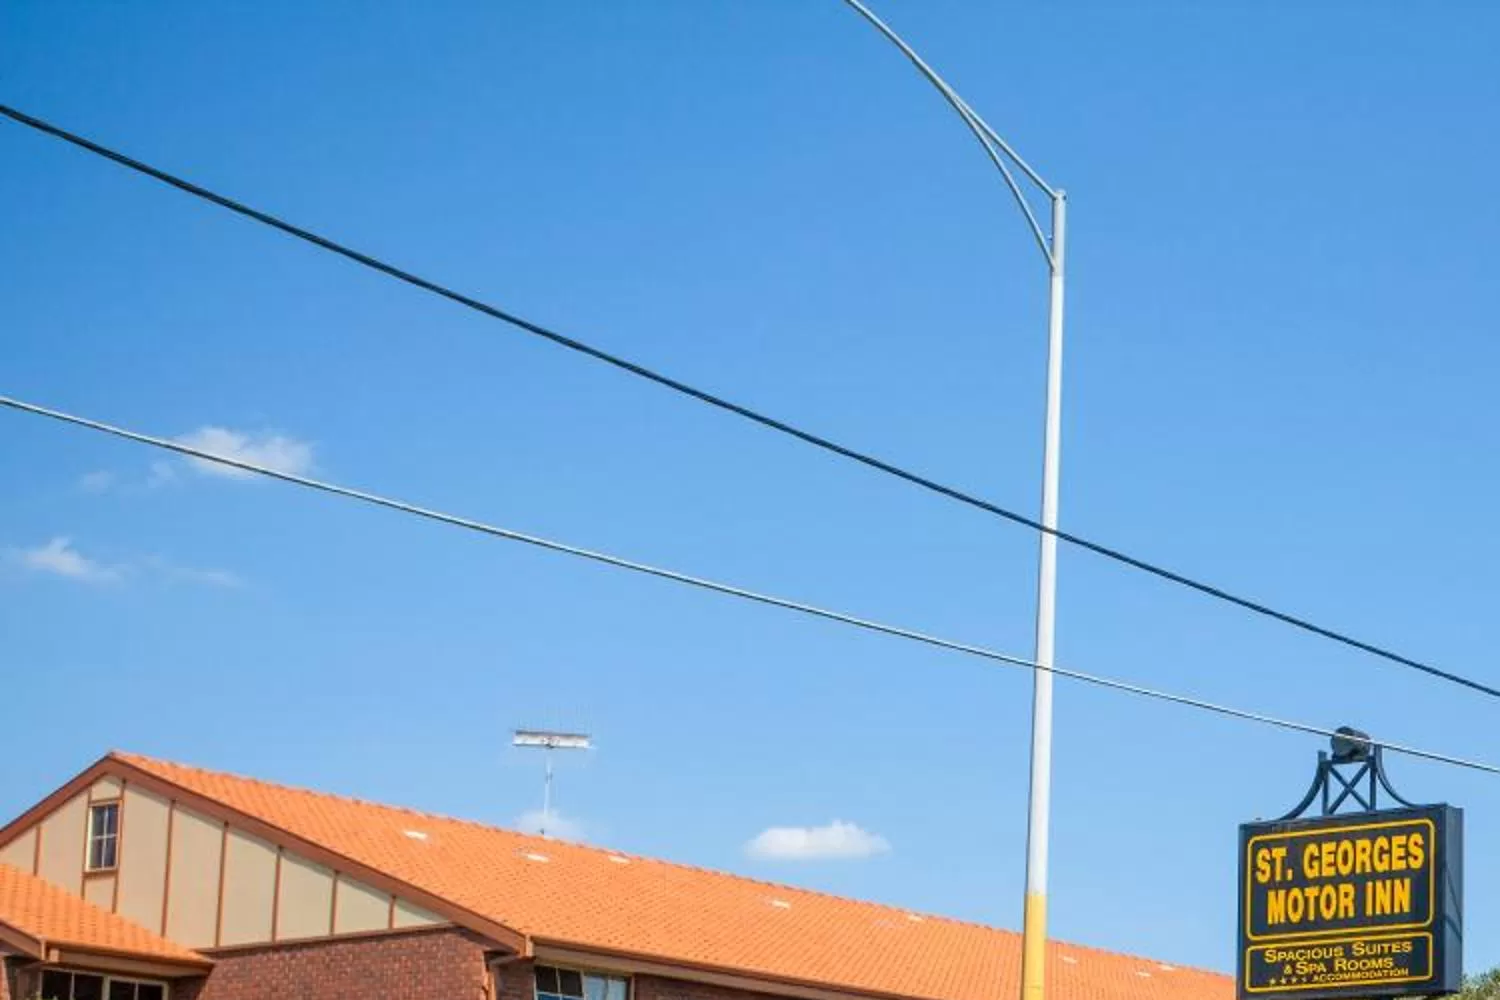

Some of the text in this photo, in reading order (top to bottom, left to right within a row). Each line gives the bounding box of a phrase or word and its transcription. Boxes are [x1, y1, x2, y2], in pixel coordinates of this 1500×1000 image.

[1256, 832, 1424, 883] ST. GEORGES
[1267, 878, 1411, 925] MOTOR INN
[1264, 941, 1413, 964] SPACIOUS SUITES
[1283, 957, 1394, 976] & SPA ROOMS
[1312, 967, 1409, 982] ACCOMMODATION
